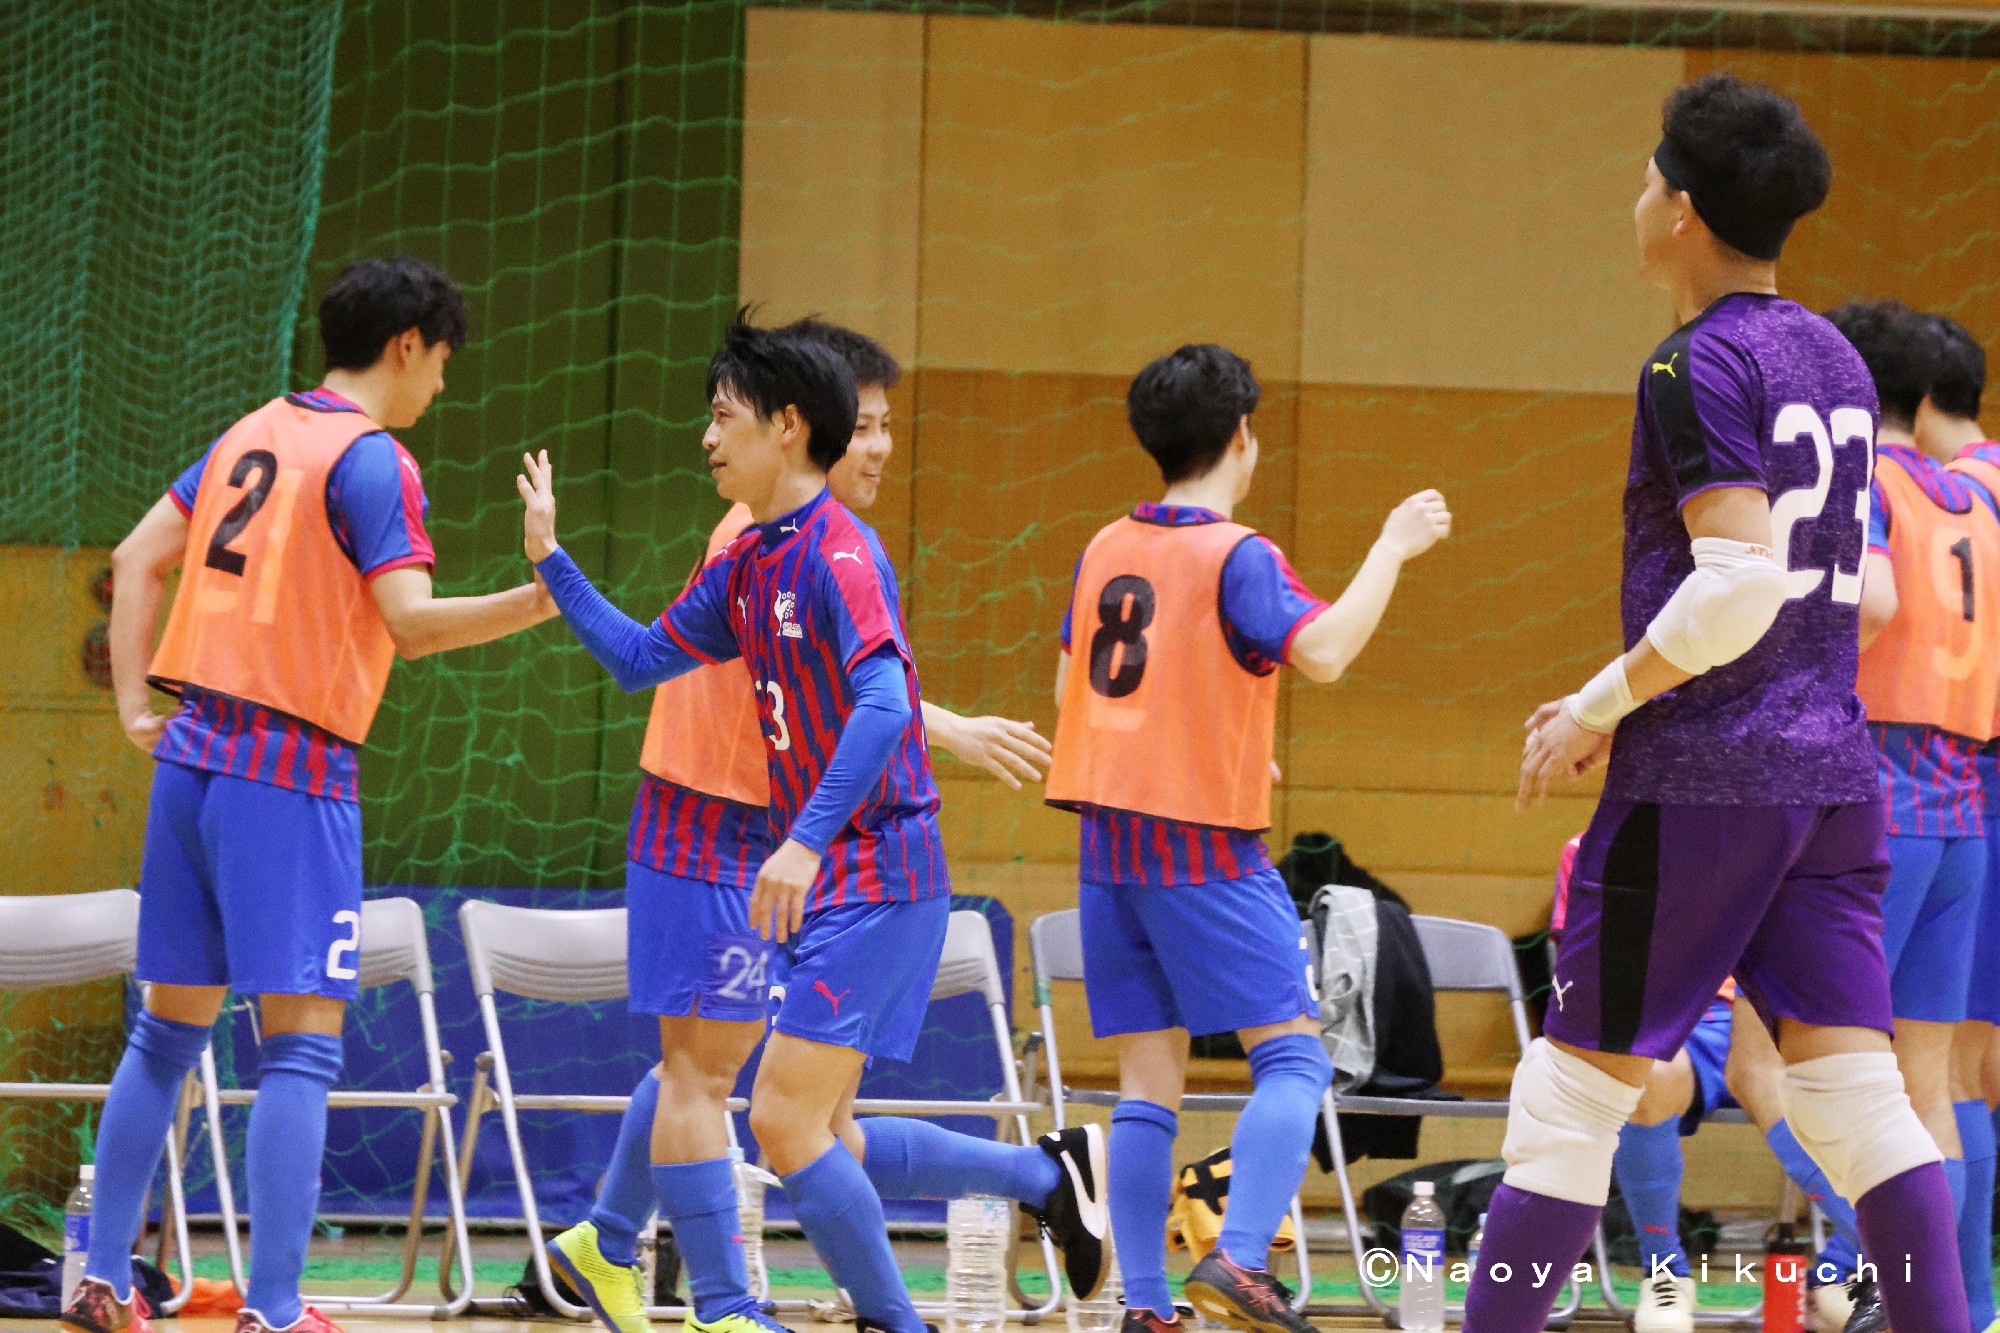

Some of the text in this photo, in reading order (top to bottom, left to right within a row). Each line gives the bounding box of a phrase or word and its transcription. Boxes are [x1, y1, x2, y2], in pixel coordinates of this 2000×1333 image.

[205, 449, 277, 577] 2
[1771, 404, 1874, 604] 23
[1090, 574, 1155, 698] 8
[1950, 537, 1975, 622] 1
[716, 946, 769, 1001] 24
